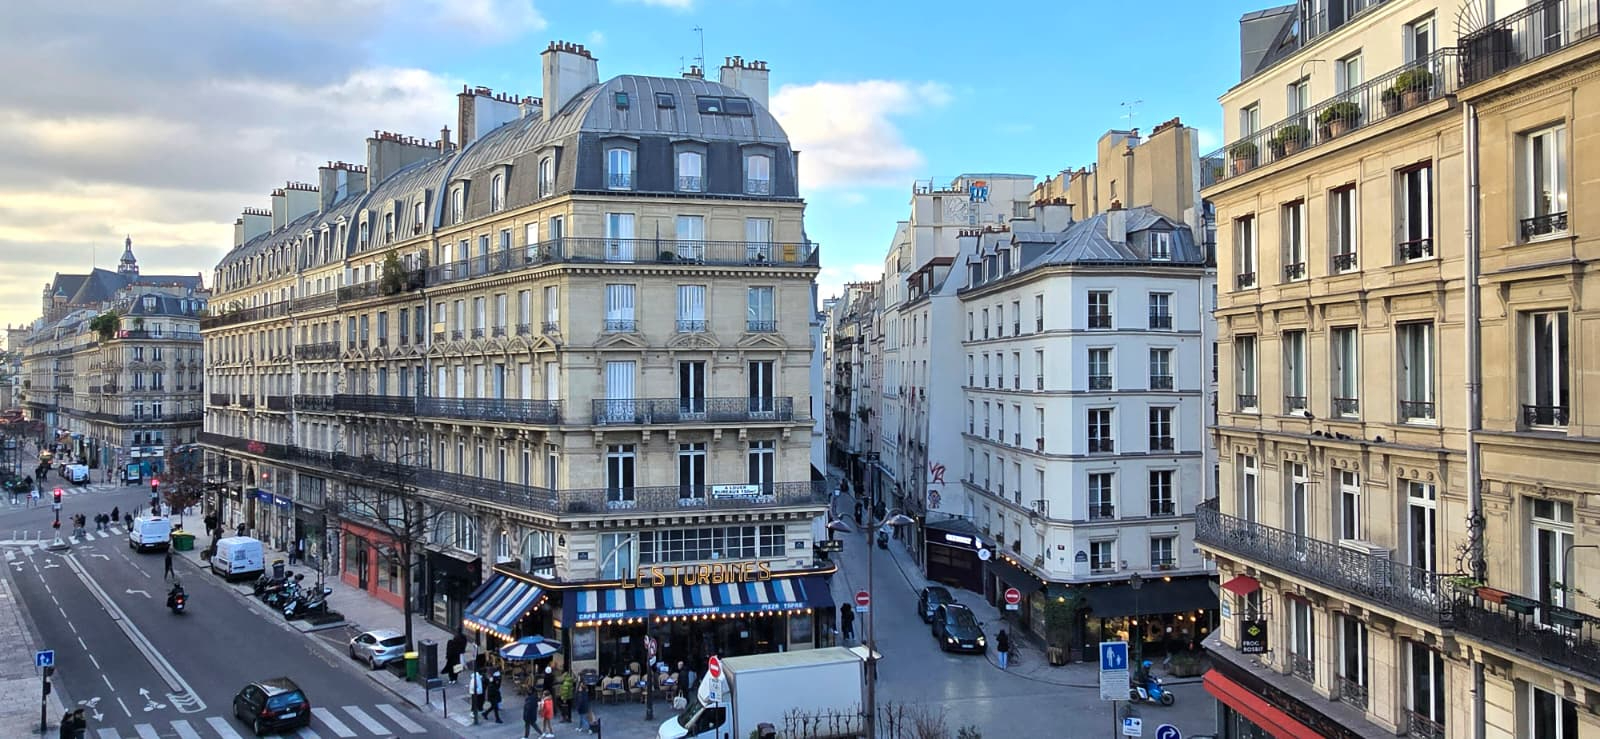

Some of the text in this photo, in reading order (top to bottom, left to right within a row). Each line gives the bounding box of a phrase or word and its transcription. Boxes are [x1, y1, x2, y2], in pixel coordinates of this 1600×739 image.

[622, 561, 771, 589] LES TURBINES
[666, 606, 720, 615] SERVICE CONTINU
[761, 601, 803, 611] PIZZA TAPAS
[598, 611, 624, 619] BRUNCH
